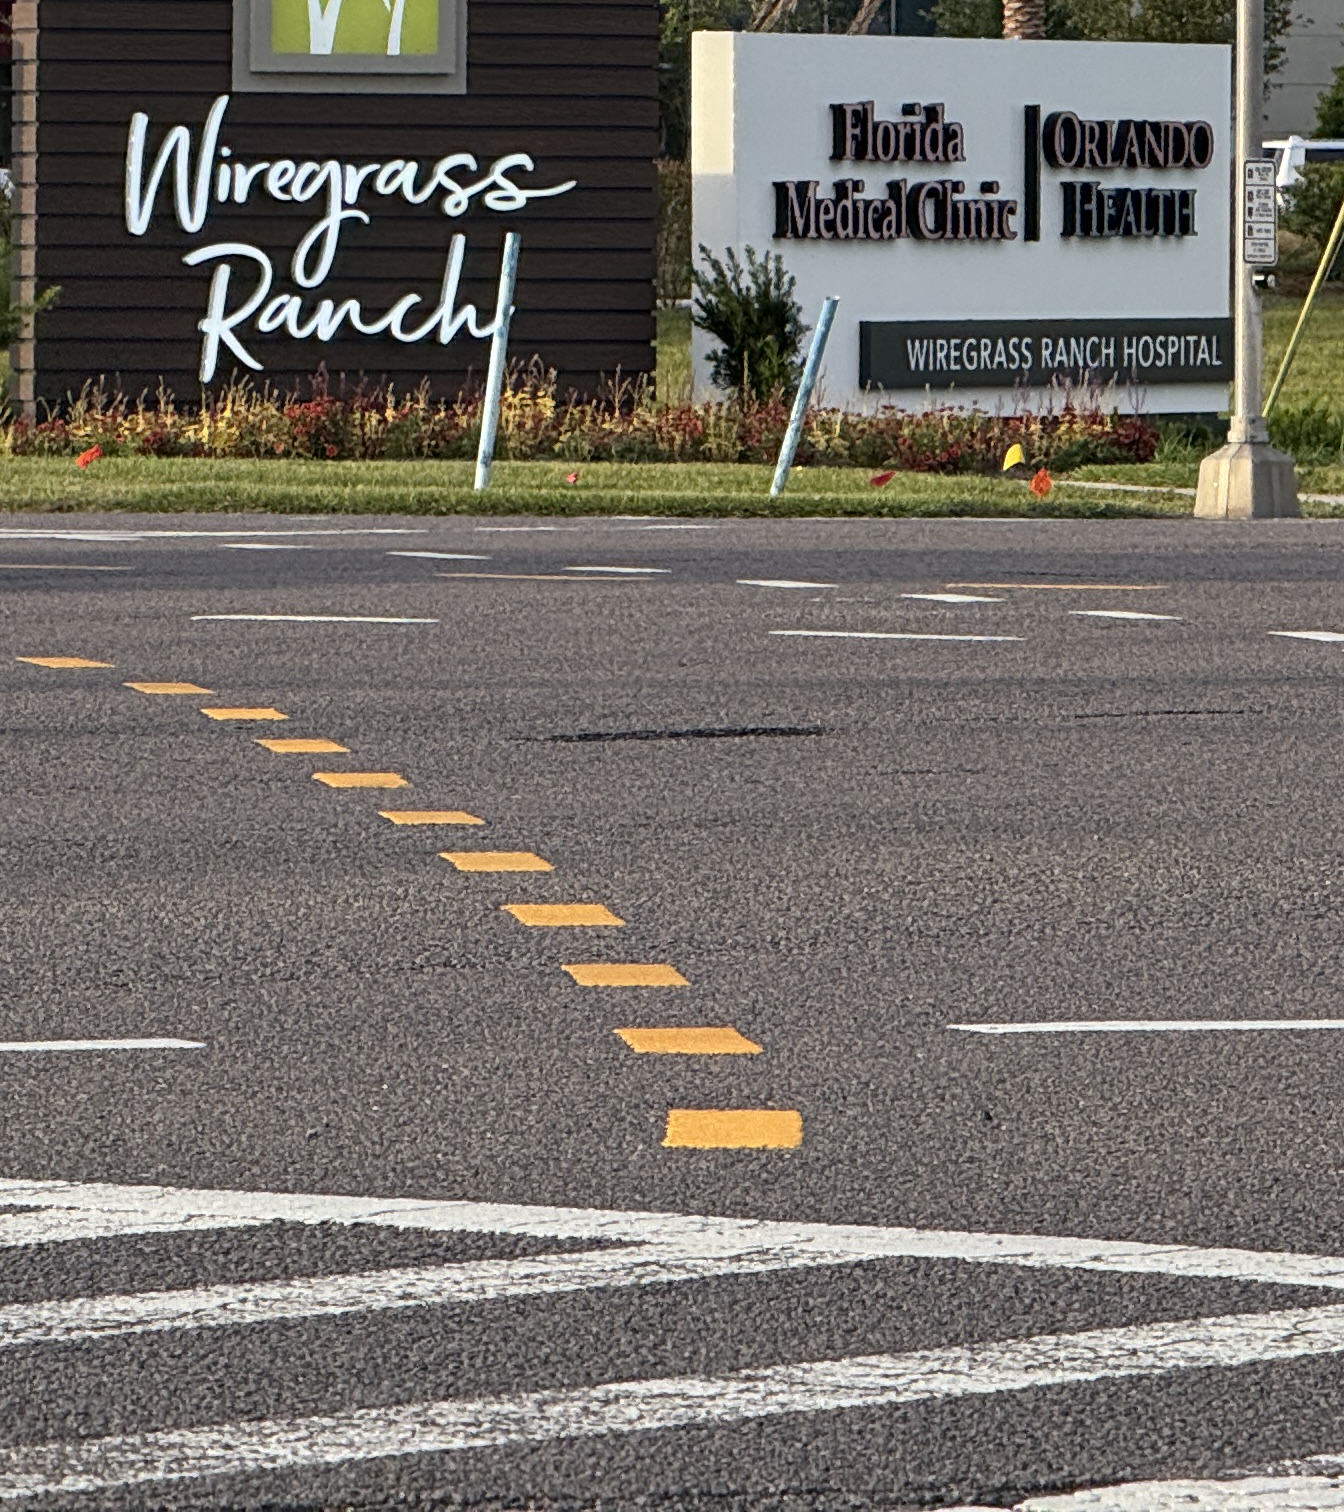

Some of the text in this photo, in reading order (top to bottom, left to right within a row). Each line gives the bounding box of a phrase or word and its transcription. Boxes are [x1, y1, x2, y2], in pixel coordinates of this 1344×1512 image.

[829, 100, 967, 162] Florida
[1043, 110, 1214, 169] ORLANDO
[125, 94, 577, 288] Wiregrass
[772, 178, 1018, 240] Medical Clinic
[1060, 181, 1198, 237] HEALTH
[182, 232, 516, 385] Ranch
[906, 335, 1223, 371] WIREGRASS RANCH HOSPITAL
